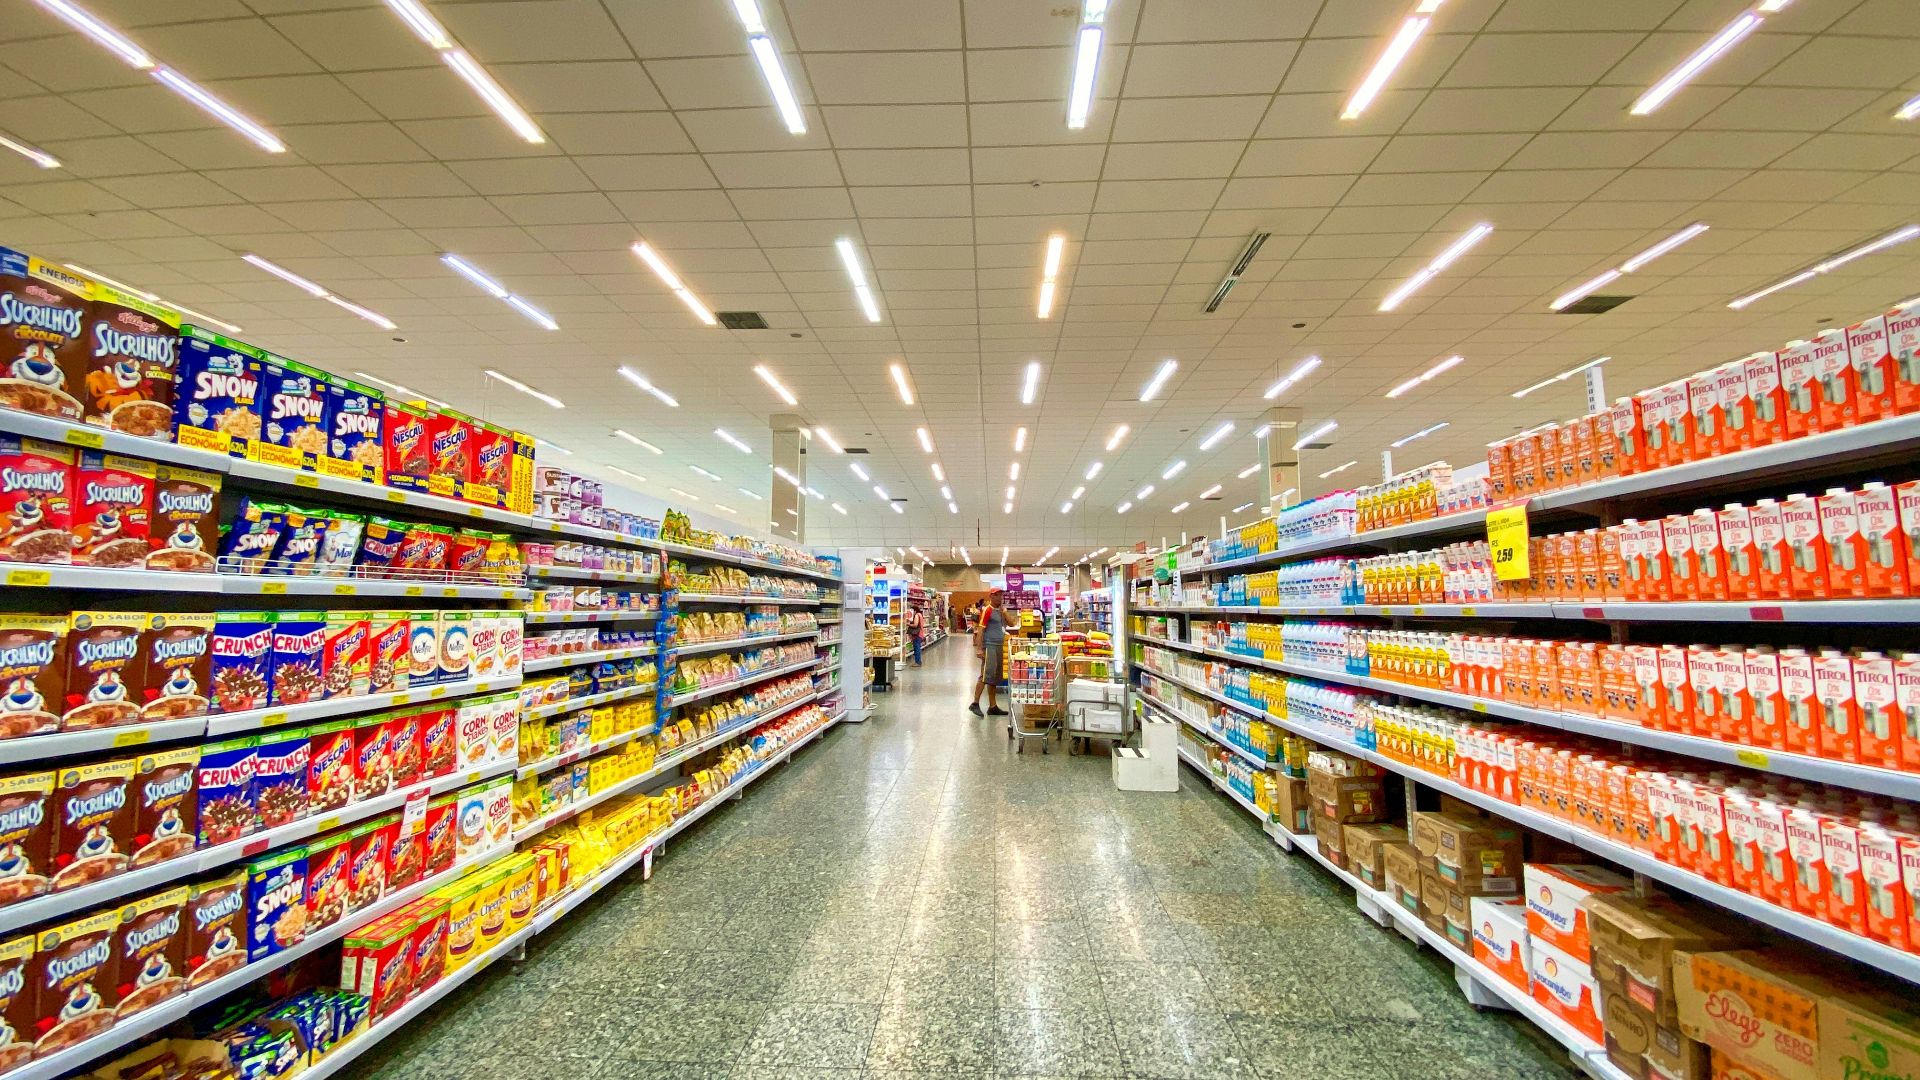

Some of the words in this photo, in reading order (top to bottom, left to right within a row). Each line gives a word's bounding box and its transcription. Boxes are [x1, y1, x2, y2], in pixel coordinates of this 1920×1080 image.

[0, 293, 83, 338] SUCRILHOS
[95, 322, 177, 368] SUCRILHOS
[1850, 330, 1885, 348] TIROL
[1813, 342, 1846, 360] TIROL
[1780, 353, 1813, 370] TIROL
[1717, 374, 1745, 389] TIROL
[1747, 364, 1776, 380] TIROL
[194, 371, 258, 400] SNOW
[1690, 383, 1716, 398] TIROL
[271, 393, 324, 419] SNOW
[1642, 400, 1664, 414] TIROL
[1664, 392, 1685, 406] TIROL
[335, 411, 380, 436] SNOW
[1613, 409, 1632, 420] TIROL
[180, 434, 228, 453] ECONÔMICA
[393, 423, 425, 446] NESCAU
[433, 428, 468, 455] NESCAU
[479, 441, 509, 466] NESCAU
[2, 467, 65, 493] SUCRILHOS
[86, 481, 145, 505] SUCRILHOS
[158, 490, 213, 514] SUCRILHOS
[1783, 510, 1816, 523] TIROL
[1821, 506, 1855, 519] TIROL
[1858, 501, 1893, 514] TIROL
[1692, 523, 1716, 534] TIROL
[1721, 519, 1749, 530] TIROL
[1752, 515, 1780, 527] TIROL
[1620, 532, 1639, 542] TIROL
[1639, 529, 1660, 540] TIROL
[1665, 526, 1690, 538] TIROL
[234, 532, 280, 553] SNOW
[365, 538, 400, 557] CRUNC
[213, 630, 272, 655] CRUNCH
[274, 629, 326, 653] CRUNCH
[334, 627, 366, 657] NESCAU
[379, 626, 406, 652] NESCAU
[473, 629, 495, 646] CORN
[500, 628, 520, 644] CORN
[78, 634, 138, 667] SUCRILHOS
[154, 634, 208, 664] SUCRILHOS
[1636, 656, 1657, 668] TIROL
[1660, 658, 1684, 670] TIROL
[1690, 660, 1716, 672] TIROL
[1715, 662, 1743, 674] TIROL
[1746, 664, 1776, 677] TIROL
[1781, 666, 1811, 679] TIROL
[1815, 668, 1850, 682] TIROL
[1855, 670, 1892, 685] TIROL
[463, 715, 486, 737] CORN
[493, 709, 515, 728] CORN
[424, 715, 452, 748] NESCAU
[312, 738, 351, 778] NESCAU
[359, 730, 391, 768] NESCAU
[96, 761, 135, 773] SABOR
[257, 744, 311, 775] CRUNCH
[199, 755, 258, 786] CRUNCH
[9, 774, 54, 788] SABOR
[144, 769, 194, 808] SUCRILHOS
[1648, 786, 1670, 800] TIROL
[1672, 793, 1694, 808] TIROL
[67, 783, 127, 826] SUCRILHOS
[489, 795, 510, 818] CORN
[1695, 800, 1720, 817] TIROL
[0, 799, 45, 832] RILHOS
[1725, 809, 1754, 826] TIROL
[428, 807, 455, 846] NESCAU
[1755, 817, 1784, 834] TIROL
[1788, 825, 1820, 843] TIROL
[1823, 834, 1856, 853] TIROL
[351, 836, 384, 880] NESCAU
[1860, 844, 1897, 864] TIROL
[310, 850, 348, 899] NESCAU
[256, 877, 305, 922] SNOW
[195, 889, 243, 931] SUCRILHOS
[125, 910, 180, 958] SUCRILHOS
[48, 936, 111, 989] SUCRILHOS
